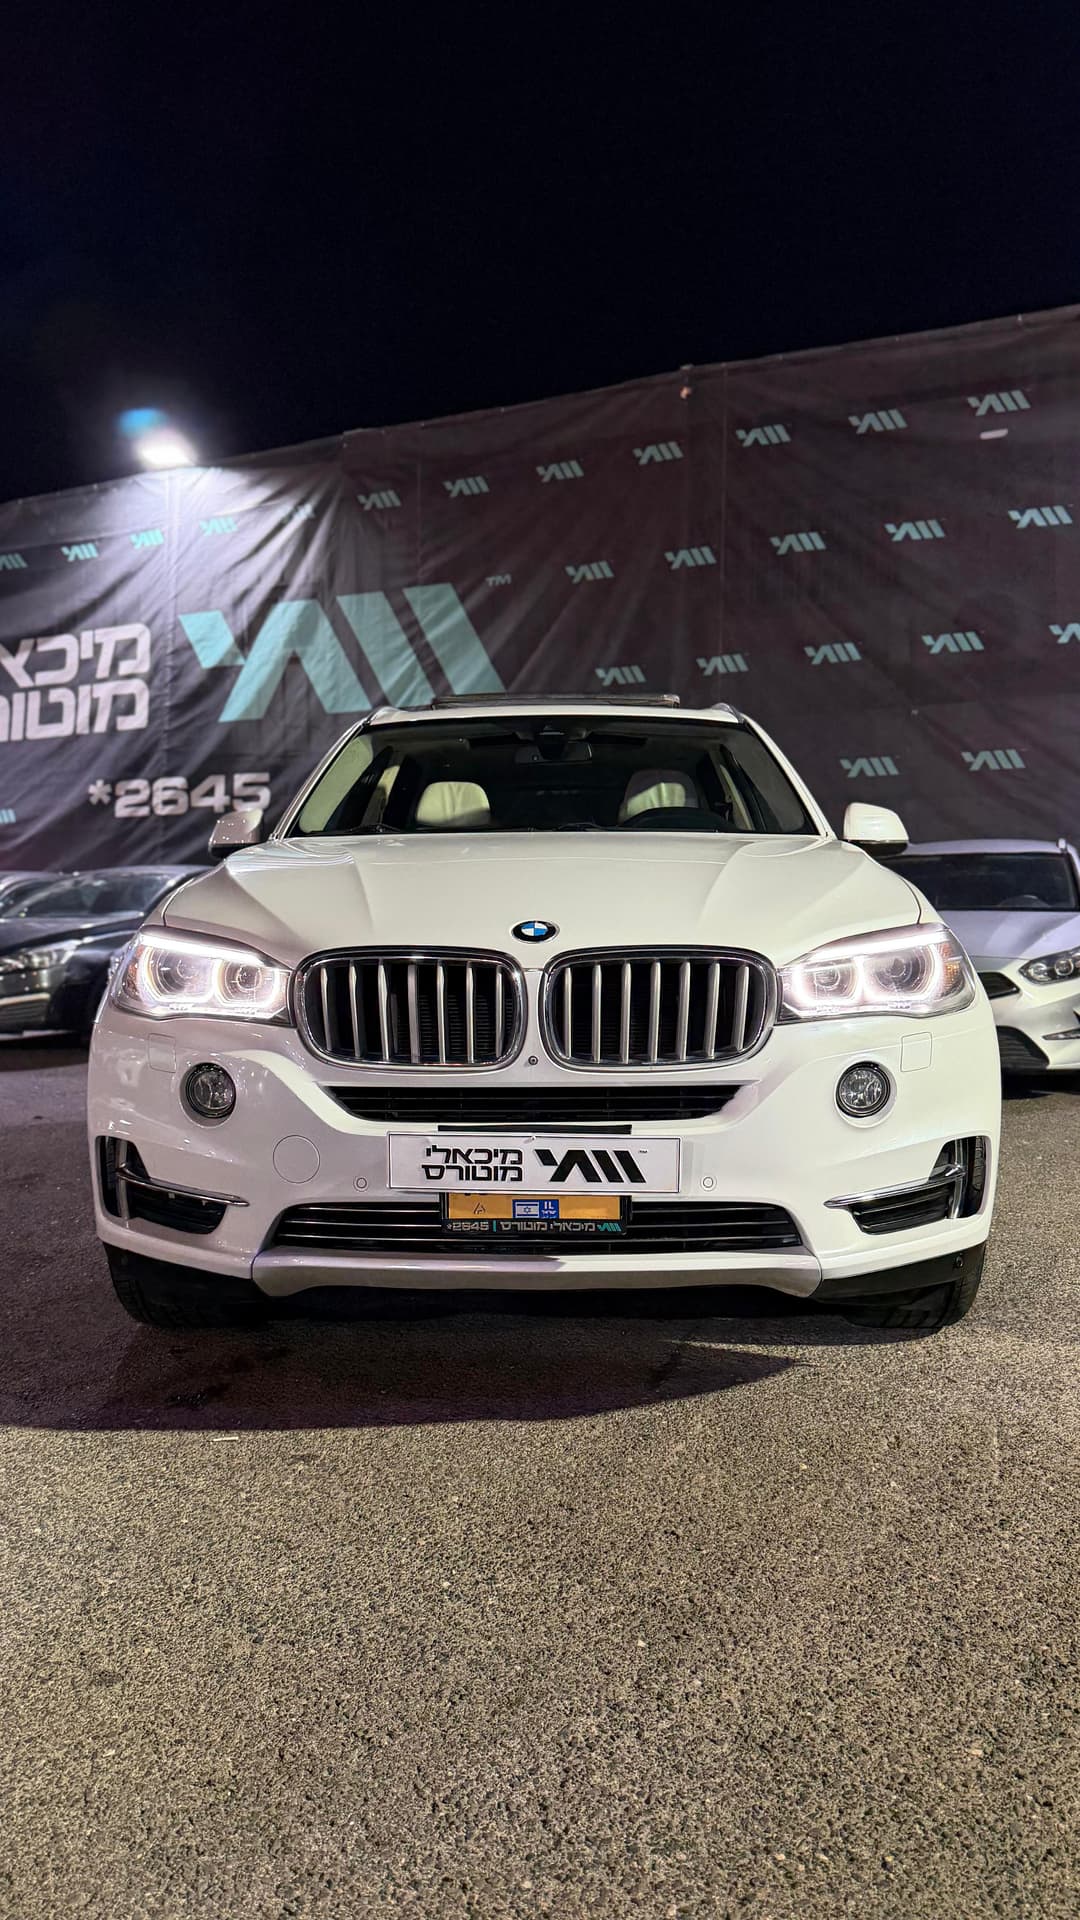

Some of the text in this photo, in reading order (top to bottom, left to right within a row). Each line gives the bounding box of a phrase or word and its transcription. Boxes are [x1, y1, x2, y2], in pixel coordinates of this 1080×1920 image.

[0, 678, 149, 742] מוטו
[425, 1145, 523, 1165] מיכאלי
[421, 1164, 523, 1182] מוטורס
[544, 1201, 555, 1210] IL
[500, 1221, 547, 1231] מוטורס
[550, 1220, 595, 1232] מיכאלי
